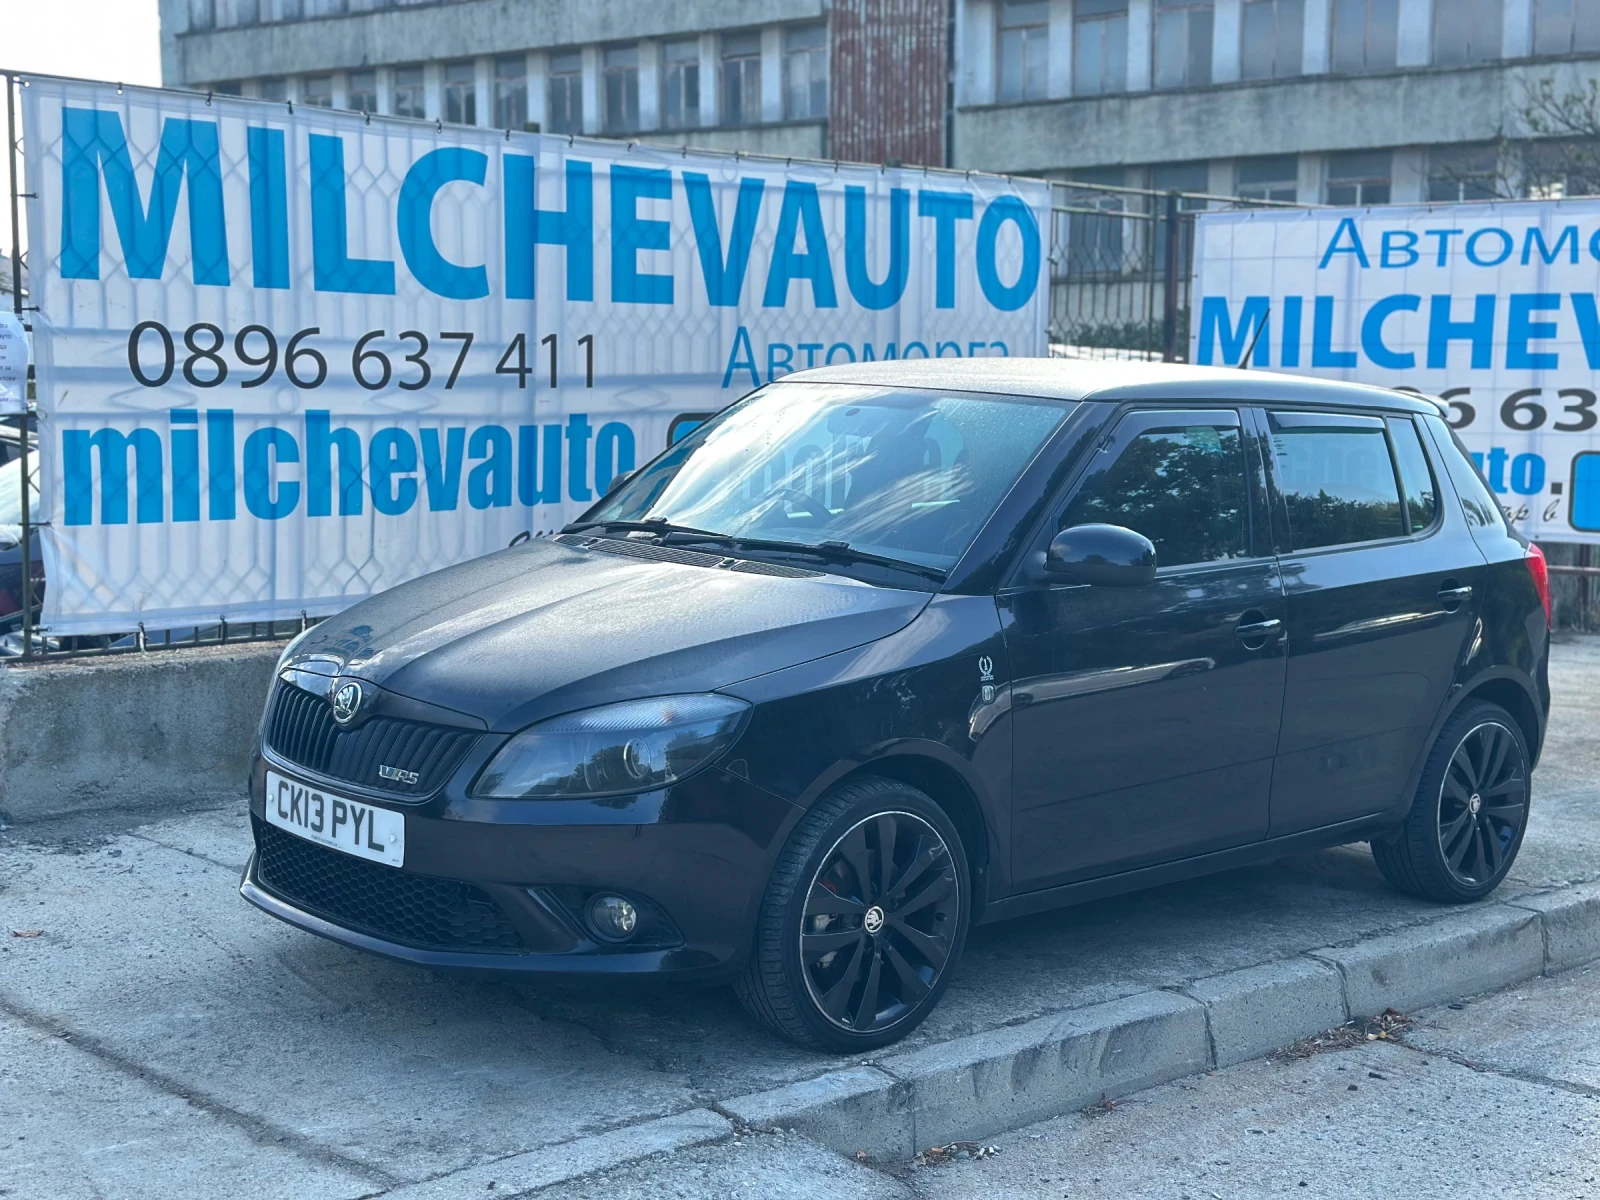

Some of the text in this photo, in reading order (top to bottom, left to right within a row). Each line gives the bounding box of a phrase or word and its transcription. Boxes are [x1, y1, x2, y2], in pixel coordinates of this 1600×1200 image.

[59, 105, 1042, 313] MILCHEVAUTO
[1318, 216, 1600, 270] Автом
[126, 319, 597, 391] 0896 637 411
[61, 407, 636, 527] milchevauto
[277, 779, 385, 853] CK13 PYL
